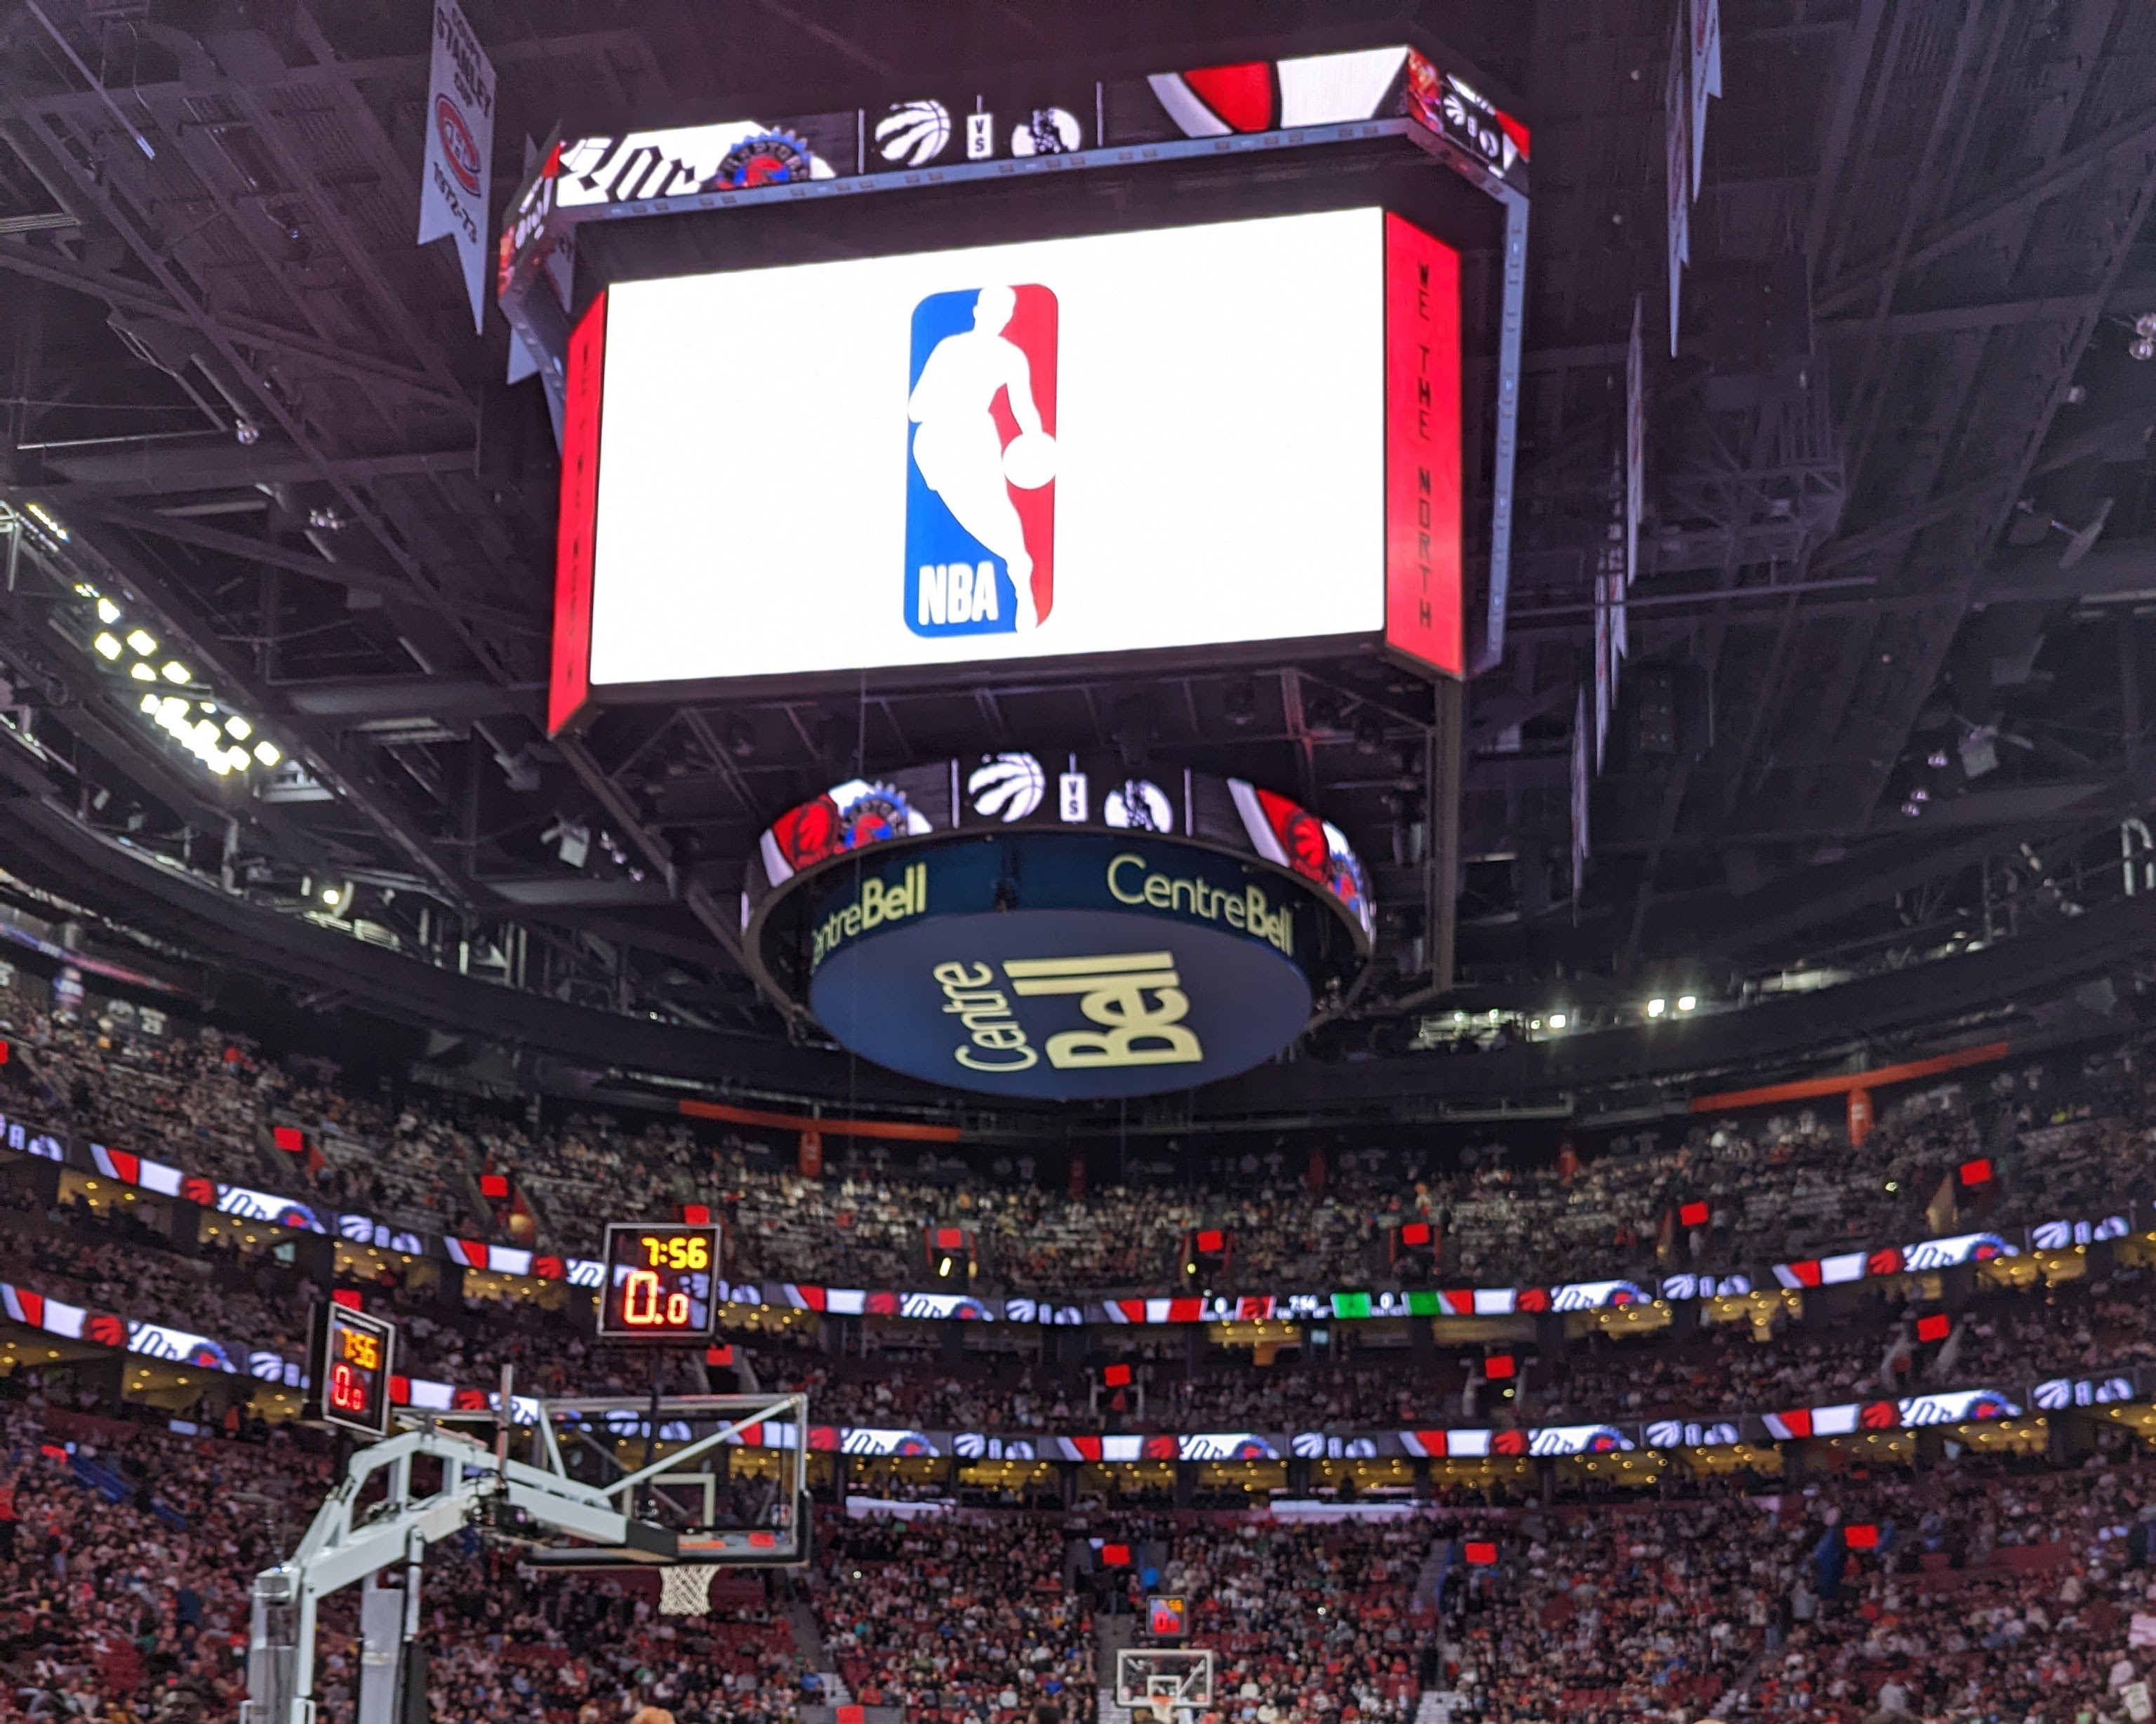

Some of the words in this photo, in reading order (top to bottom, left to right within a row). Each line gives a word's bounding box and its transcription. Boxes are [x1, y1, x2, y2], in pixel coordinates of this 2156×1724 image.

[918, 561, 999, 626] NBA
[1107, 853, 1294, 958] CentreBell
[933, 961, 1039, 1073] Centre
[1002, 950, 1204, 1071] Bell
[641, 1236, 709, 1269] 7:56
[624, 1271, 691, 1325] 0.0
